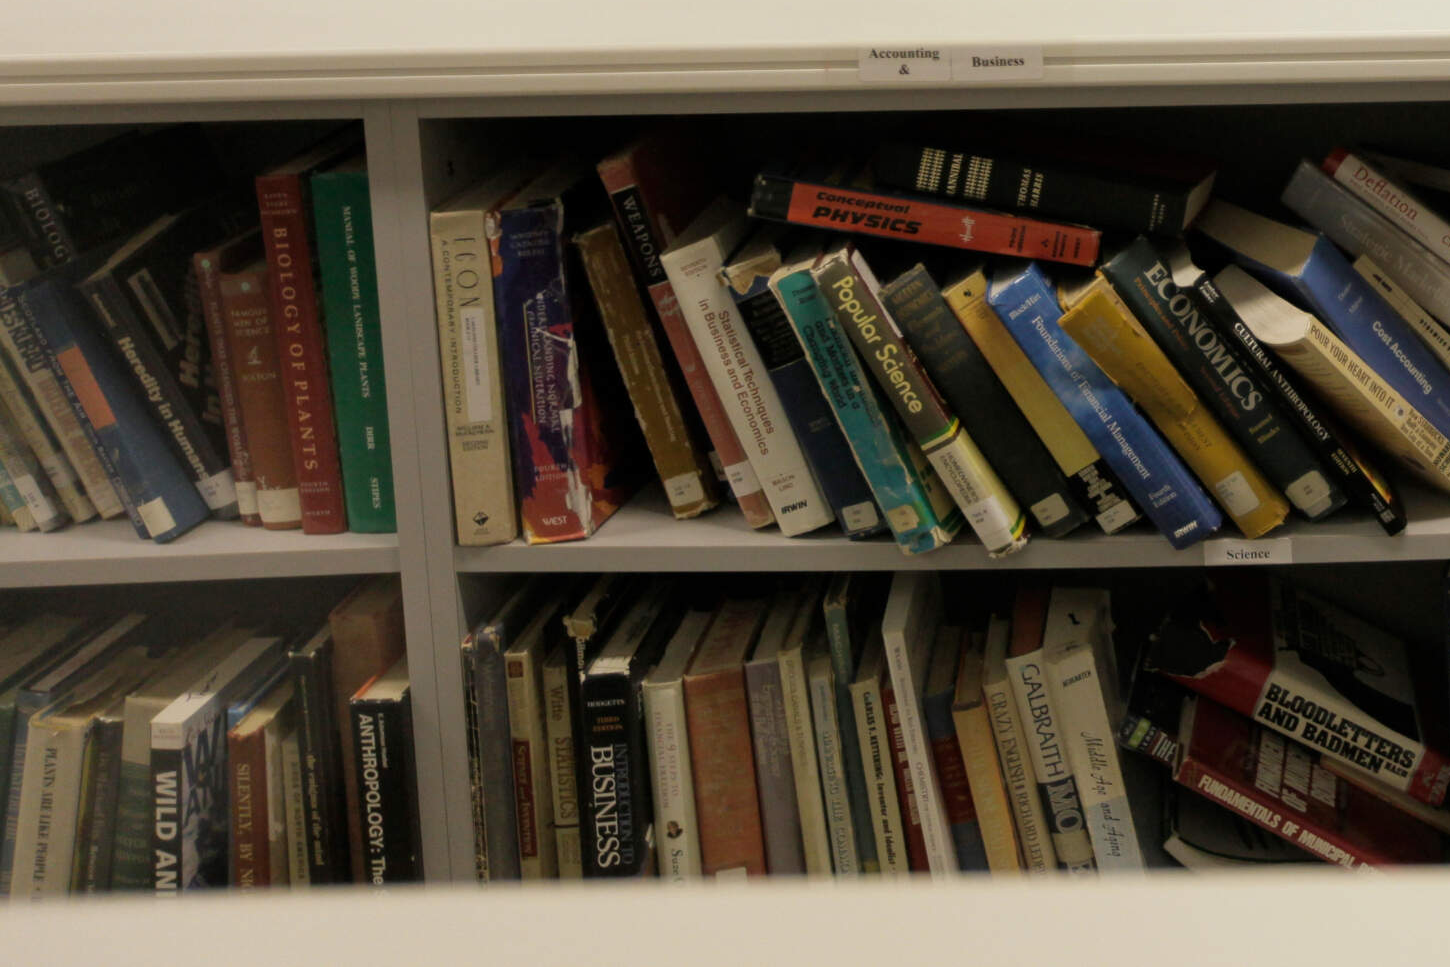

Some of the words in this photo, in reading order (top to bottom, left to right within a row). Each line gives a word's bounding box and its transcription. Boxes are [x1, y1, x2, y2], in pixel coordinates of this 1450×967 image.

[868, 48, 940, 61] Accounting
[899, 64, 910, 75] &
[972, 56, 1025, 68] Business
[815, 190, 911, 214] conceptual
[1017, 167, 1032, 207] THOMAS
[1030, 171, 1045, 208] HARRIS
[1352, 165, 1419, 221] Deflation
[342, 205, 356, 246] MANUAL
[622, 194, 664, 278] WEAPONS
[812, 205, 924, 235] PHYSICS
[347, 249, 357, 262] OF
[272, 227, 300, 334] BIOLOGY
[350, 265, 362, 300] WOODY
[697, 298, 708, 309] in
[352, 304, 368, 359] LANDSCAPE
[442, 250, 455, 333] CONTEMPORARY
[450, 337, 463, 415] INTRODUCTION
[702, 311, 732, 366] Business
[832, 275, 882, 344] Popular
[875, 342, 923, 414] Science
[1030, 314, 1074, 373] Foundations
[1143, 259, 1263, 412] ECONOMICS
[118, 336, 163, 403] Heredity
[158, 402, 174, 421] in
[289, 343, 305, 371] OF
[717, 310, 753, 368] Statistical
[744, 368, 776, 435] Techniques
[802, 325, 833, 379] Changing
[828, 379, 848, 410] World
[1069, 369, 1085, 383] of
[1310, 323, 1332, 346] POUR
[1330, 343, 1354, 366] YOUR
[1348, 359, 1371, 386] HEART
[1368, 382, 1387, 403] INTO
[1382, 395, 1396, 410] IT
[1372, 320, 1394, 346] Cost
[1388, 343, 1434, 395] Accounting
[359, 362, 371, 398] PLANTS
[726, 367, 745, 392] and
[1232, 321, 1274, 371] CULTURAL
[1270, 367, 1331, 442] ANTHROPOLOGY
[736, 391, 770, 456] Economics
[1076, 380, 1113, 424] Financial
[293, 380, 319, 472] PLANTS
[1105, 417, 1153, 480] Management
[542, 515, 568, 526] WEST
[780, 498, 809, 515] IRWIN
[1226, 549, 1271, 560] Science
[990, 691, 1014, 734] CRAZY
[1019, 662, 1064, 779] GALBRAITH
[1264, 681, 1417, 772] BLOODLETTERS
[1080, 728, 1108, 772] Middle
[1149, 730, 1181, 764] THE
[1257, 701, 1300, 733] AND
[1301, 723, 1384, 775] BADMEN
[554, 737, 576, 819] STATISTICS
[1001, 738, 1025, 784] ENGLISH
[235, 762, 253, 831] SILENTLY,
[358, 713, 385, 854] ANTHROPOLOGY:
[875, 782, 890, 818] Inventor
[1089, 770, 1113, 797] Age
[154, 770, 178, 842] WILD
[589, 745, 622, 870] BUSINESS
[881, 818, 892, 834] and
[1015, 790, 1039, 842] RICHARD
[1099, 800, 1119, 822] and
[1196, 774, 1283, 830] FUNDAMENTALS
[1281, 819, 1300, 840] OF
[1296, 828, 1358, 870] MUNICIPAL
[31, 843, 50, 882] PEOPLE
[240, 842, 254, 863] BY
[883, 835, 897, 866] Idealist
[1101, 822, 1127, 859] Aging
